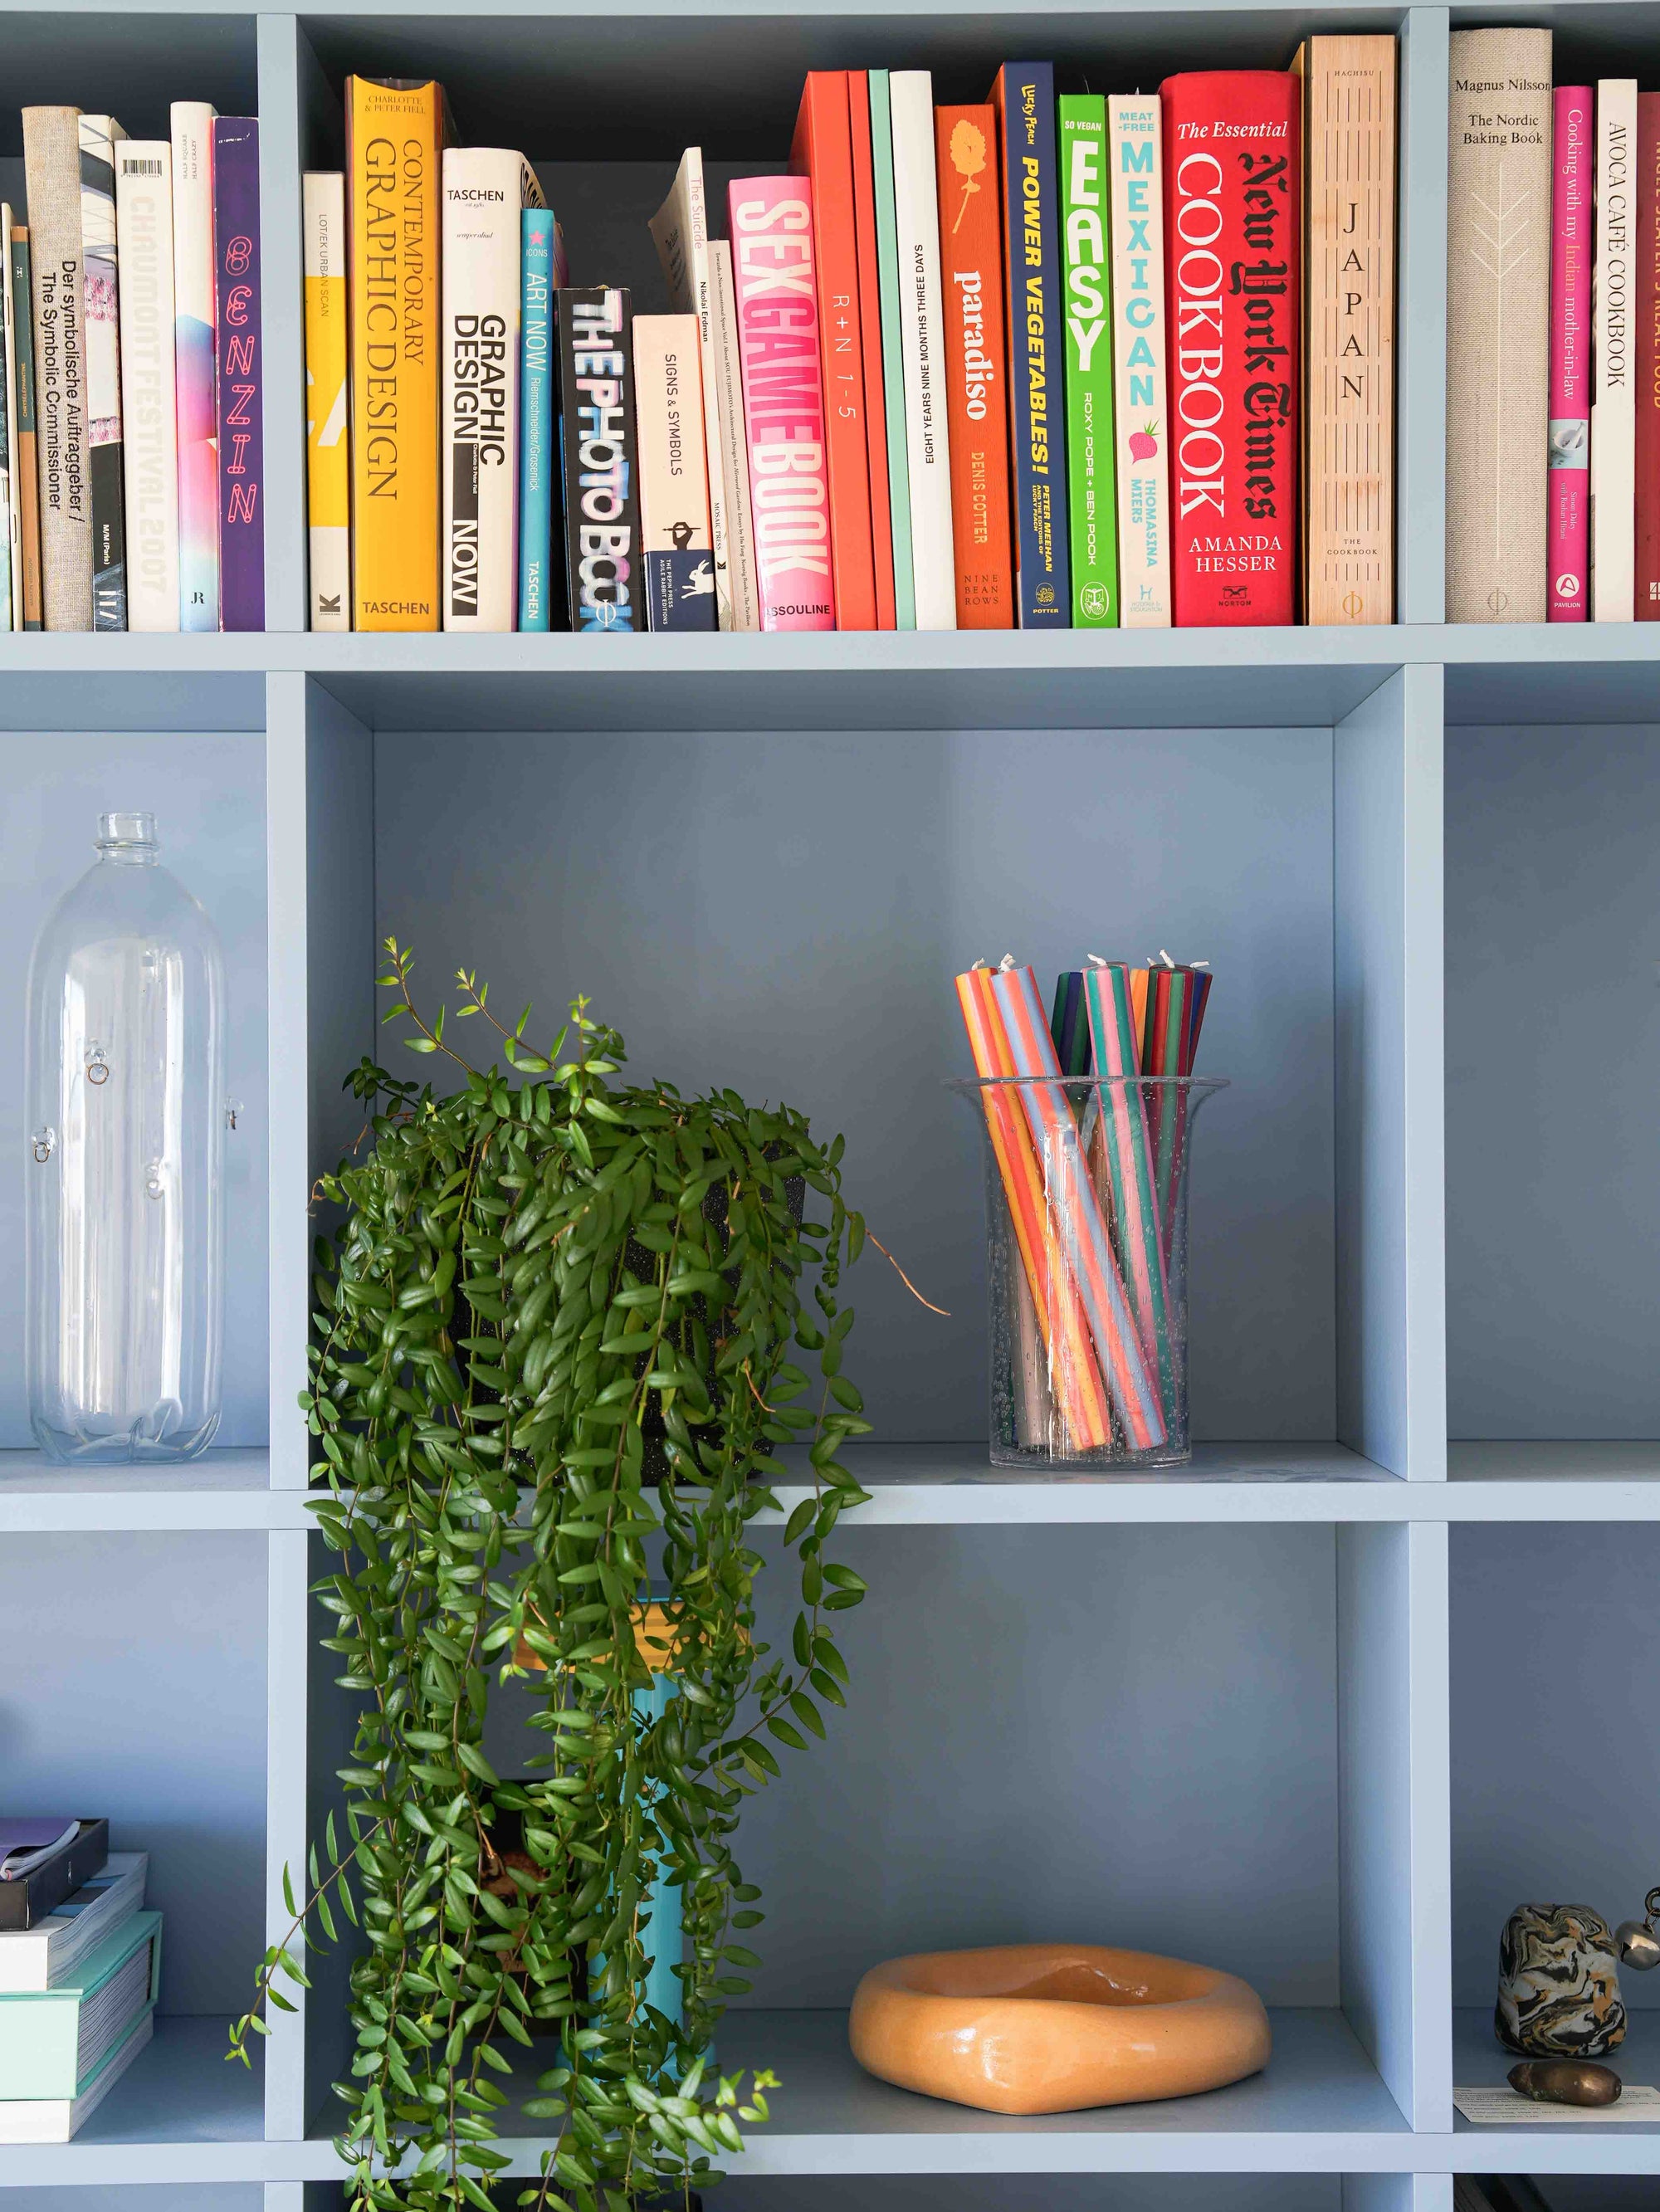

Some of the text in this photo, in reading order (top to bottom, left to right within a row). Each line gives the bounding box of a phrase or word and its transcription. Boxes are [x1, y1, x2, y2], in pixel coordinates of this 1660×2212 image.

[368, 95, 422, 105] CHARLOTTE
[374, 105, 401, 113] PETER
[403, 105, 426, 114] FIELL
[1119, 112, 1154, 121] MEAT
[1454, 79, 1550, 93] Magnus Nilsson
[1064, 120, 1101, 131] SO VEGAN
[1178, 120, 1288, 139] The Essential
[1463, 131, 1543, 146] Baking Book
[1468, 114, 1539, 126] The Nordic
[447, 189, 505, 202] TASCHEN
[690, 177, 704, 250] The Suicide
[61, 261, 76, 291] Der
[319, 213, 330, 317] LOT/EK URBAN SCAN
[403, 139, 423, 366] CONTEMPORARY
[525, 248, 548, 257] ICONS
[1067, 139, 1106, 371] EASY
[1121, 141, 1156, 406] MEXICAN
[1562, 108, 1584, 400] Cooking with my Indian mother-in-law
[1607, 122, 1629, 388] AVOCA CAFÉ COOKBOOK
[365, 138, 398, 501] GRAPHIC DESIGN
[526, 272, 547, 372] ART NOW
[700, 281, 710, 342] Nikolai Erdman
[1022, 156, 1049, 476] POWER VEGETABLES!
[1340, 203, 1365, 398] JAPAN
[61, 295, 80, 399] symbolische
[914, 244, 935, 464] EIGHT YEARS NINE MONTHS THREE DAYS
[954, 270, 994, 422] paradiso
[1177, 152, 1225, 520] COOKBOOK
[1228, 152, 1291, 520] New York Times
[41, 271, 61, 510] The Symbolic Commissioner
[480, 314, 506, 466] GRAPHIC
[665, 354, 678, 396] SIGNS
[134, 370, 164, 513] FESTIVAL
[530, 377, 541, 491] Riemschneider/Grosenick
[668, 411, 682, 476] SYMBOLS
[1084, 392, 1095, 433] ROXY
[65, 404, 82, 516] Auftraggeber
[452, 315, 479, 605] DESIGN NOW
[1085, 436, 1095, 477] POPE
[971, 452, 988, 544] DENIS COTTER
[1042, 484, 1053, 573] PETER MEEHAN
[1086, 491, 1095, 520] BEN
[1130, 478, 1143, 524] MIERS
[1145, 478, 1158, 568] THOMASINA
[102, 524, 111, 565] M/M (Paris)
[139, 519, 167, 593] 2007
[1087, 523, 1096, 565] POOK
[1189, 535, 1283, 553] AMANDA
[1196, 556, 1277, 573] HESSER
[362, 602, 430, 615] TASCHEN
[528, 561, 540, 620] TASCHEN
[964, 574, 998, 583] NINE
[964, 585, 998, 593] BEAN
[964, 597, 999, 606] ROWS
[764, 604, 831, 617] SSOULINE
